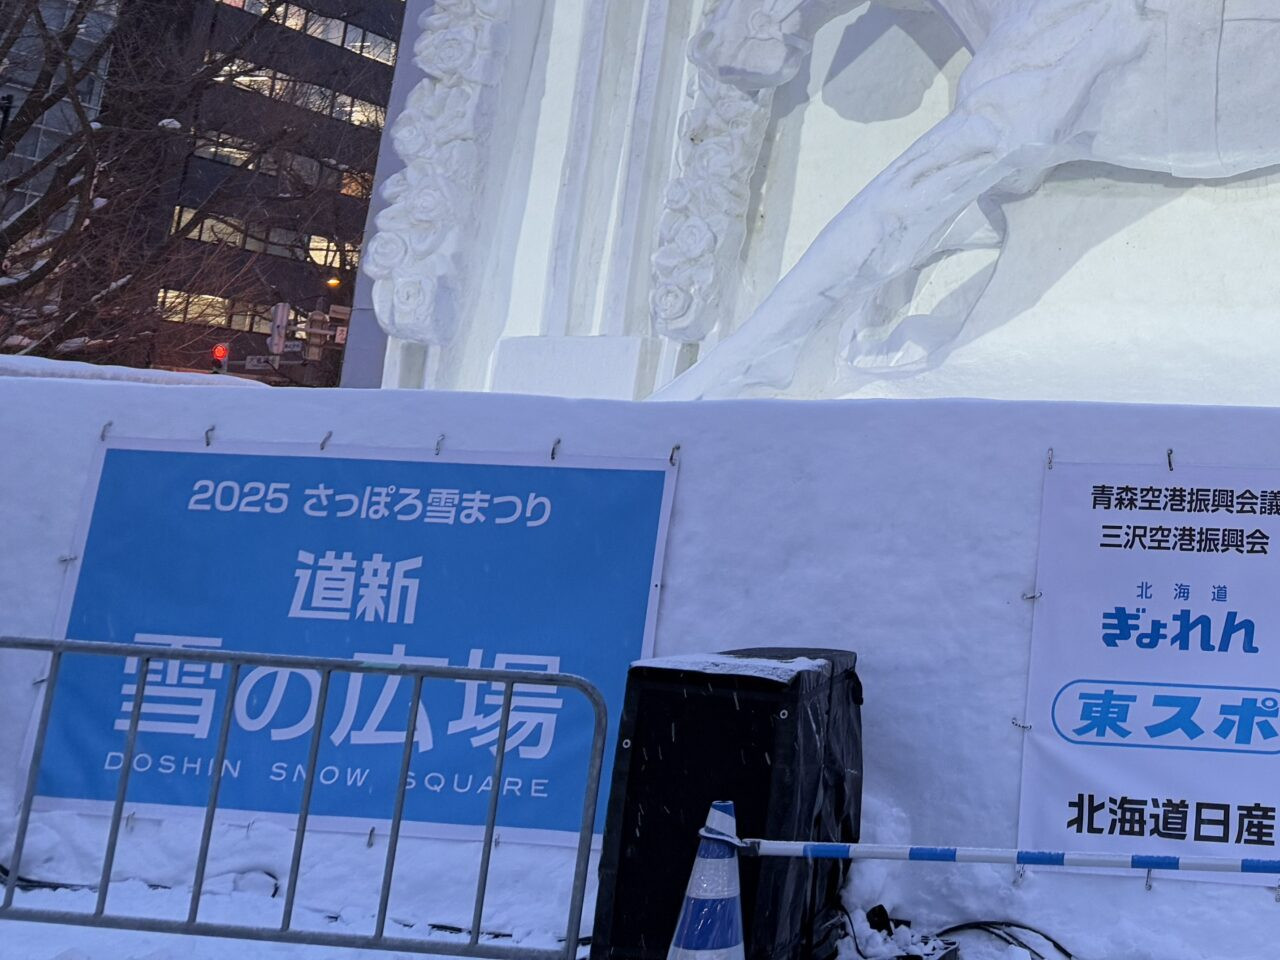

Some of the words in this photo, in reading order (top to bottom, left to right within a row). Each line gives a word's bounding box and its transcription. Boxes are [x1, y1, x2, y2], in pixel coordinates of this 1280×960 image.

[188, 480, 290, 513] 2025
[303, 483, 551, 527] さっぽろ雪まつり
[1100, 524, 1270, 555] 三沢空港振興会
[288, 550, 423, 624] 道新
[1136, 581, 1228, 603] 北海道
[1101, 606, 1260, 654] ぎょれん
[114, 632, 563, 760] 雪の広場
[1072, 689, 1280, 745] 東スポ
[104, 751, 241, 778] DOSHIN
[404, 771, 549, 797] SQUARE
[1066, 793, 1277, 847] 北海道日産
